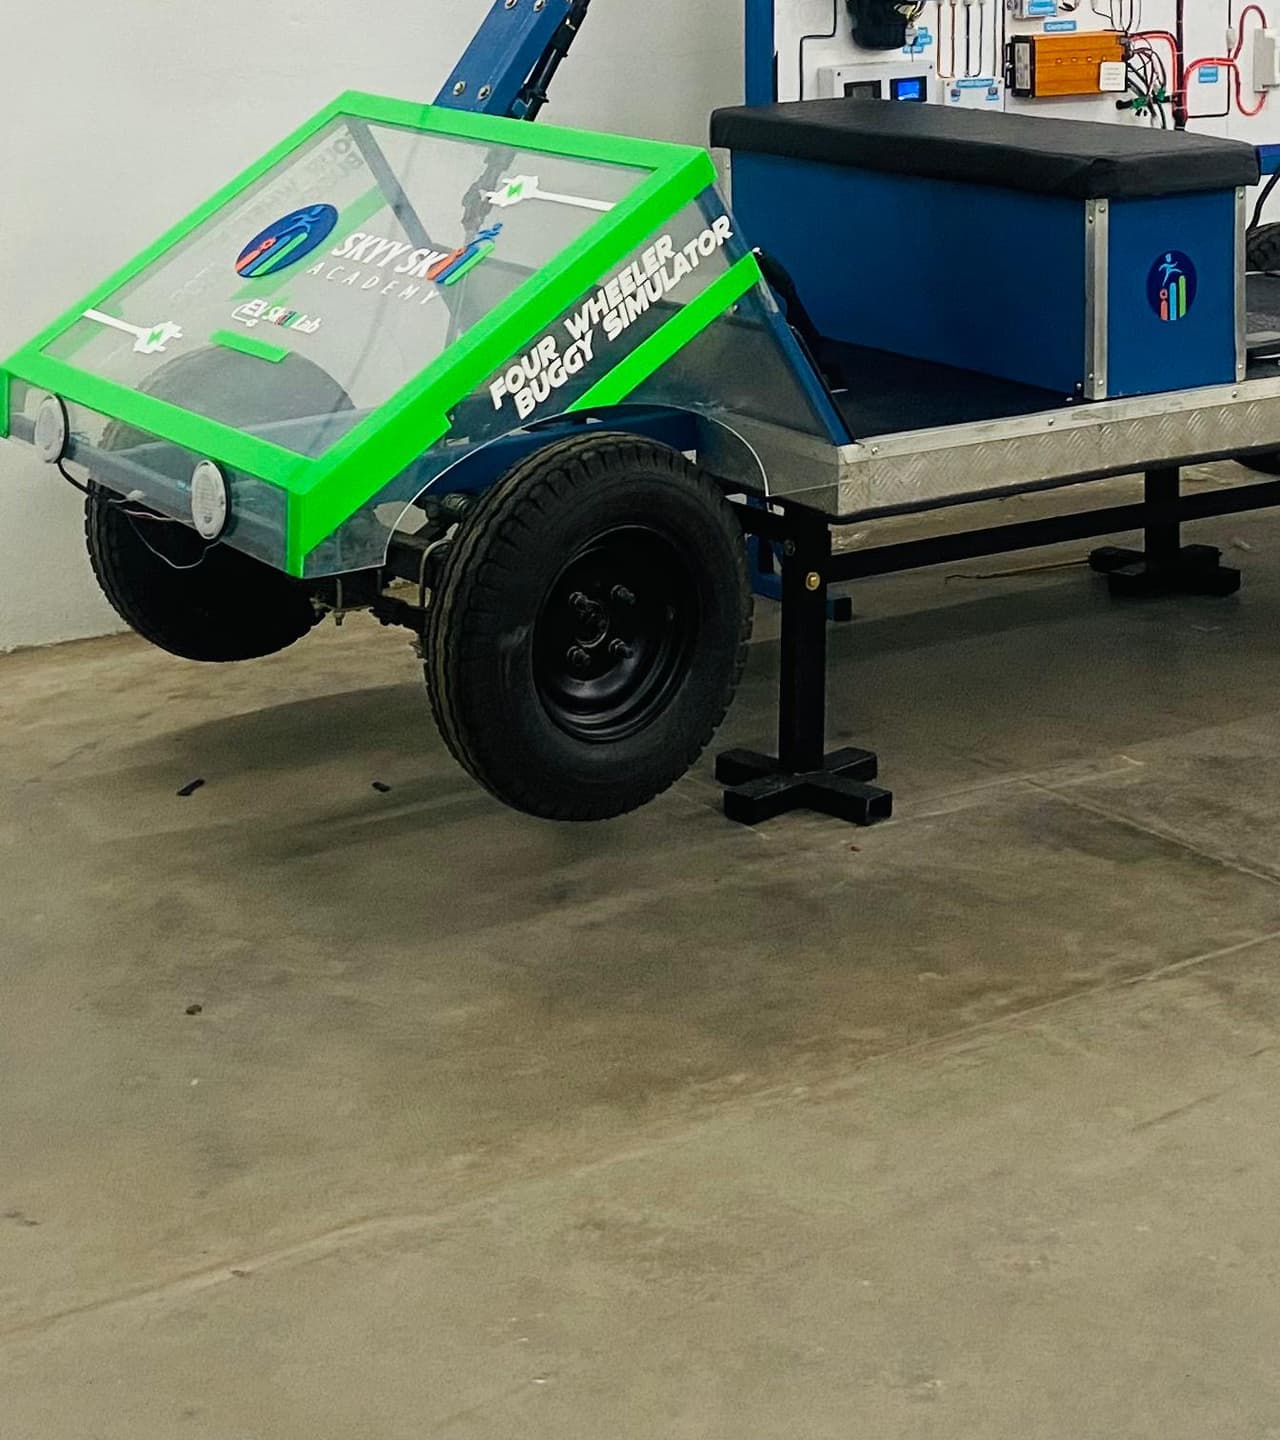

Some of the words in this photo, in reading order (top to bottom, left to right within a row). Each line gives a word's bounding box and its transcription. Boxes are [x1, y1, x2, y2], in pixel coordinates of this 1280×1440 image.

[331, 232, 411, 268] SKYY
[306, 262, 440, 305] ACADEMY
[292, 314, 321, 334] Lab
[488, 335, 559, 410] FOUR
[563, 234, 676, 340] WHEELER
[513, 330, 594, 420] BUGGY
[602, 215, 734, 342] SIMULATOR
